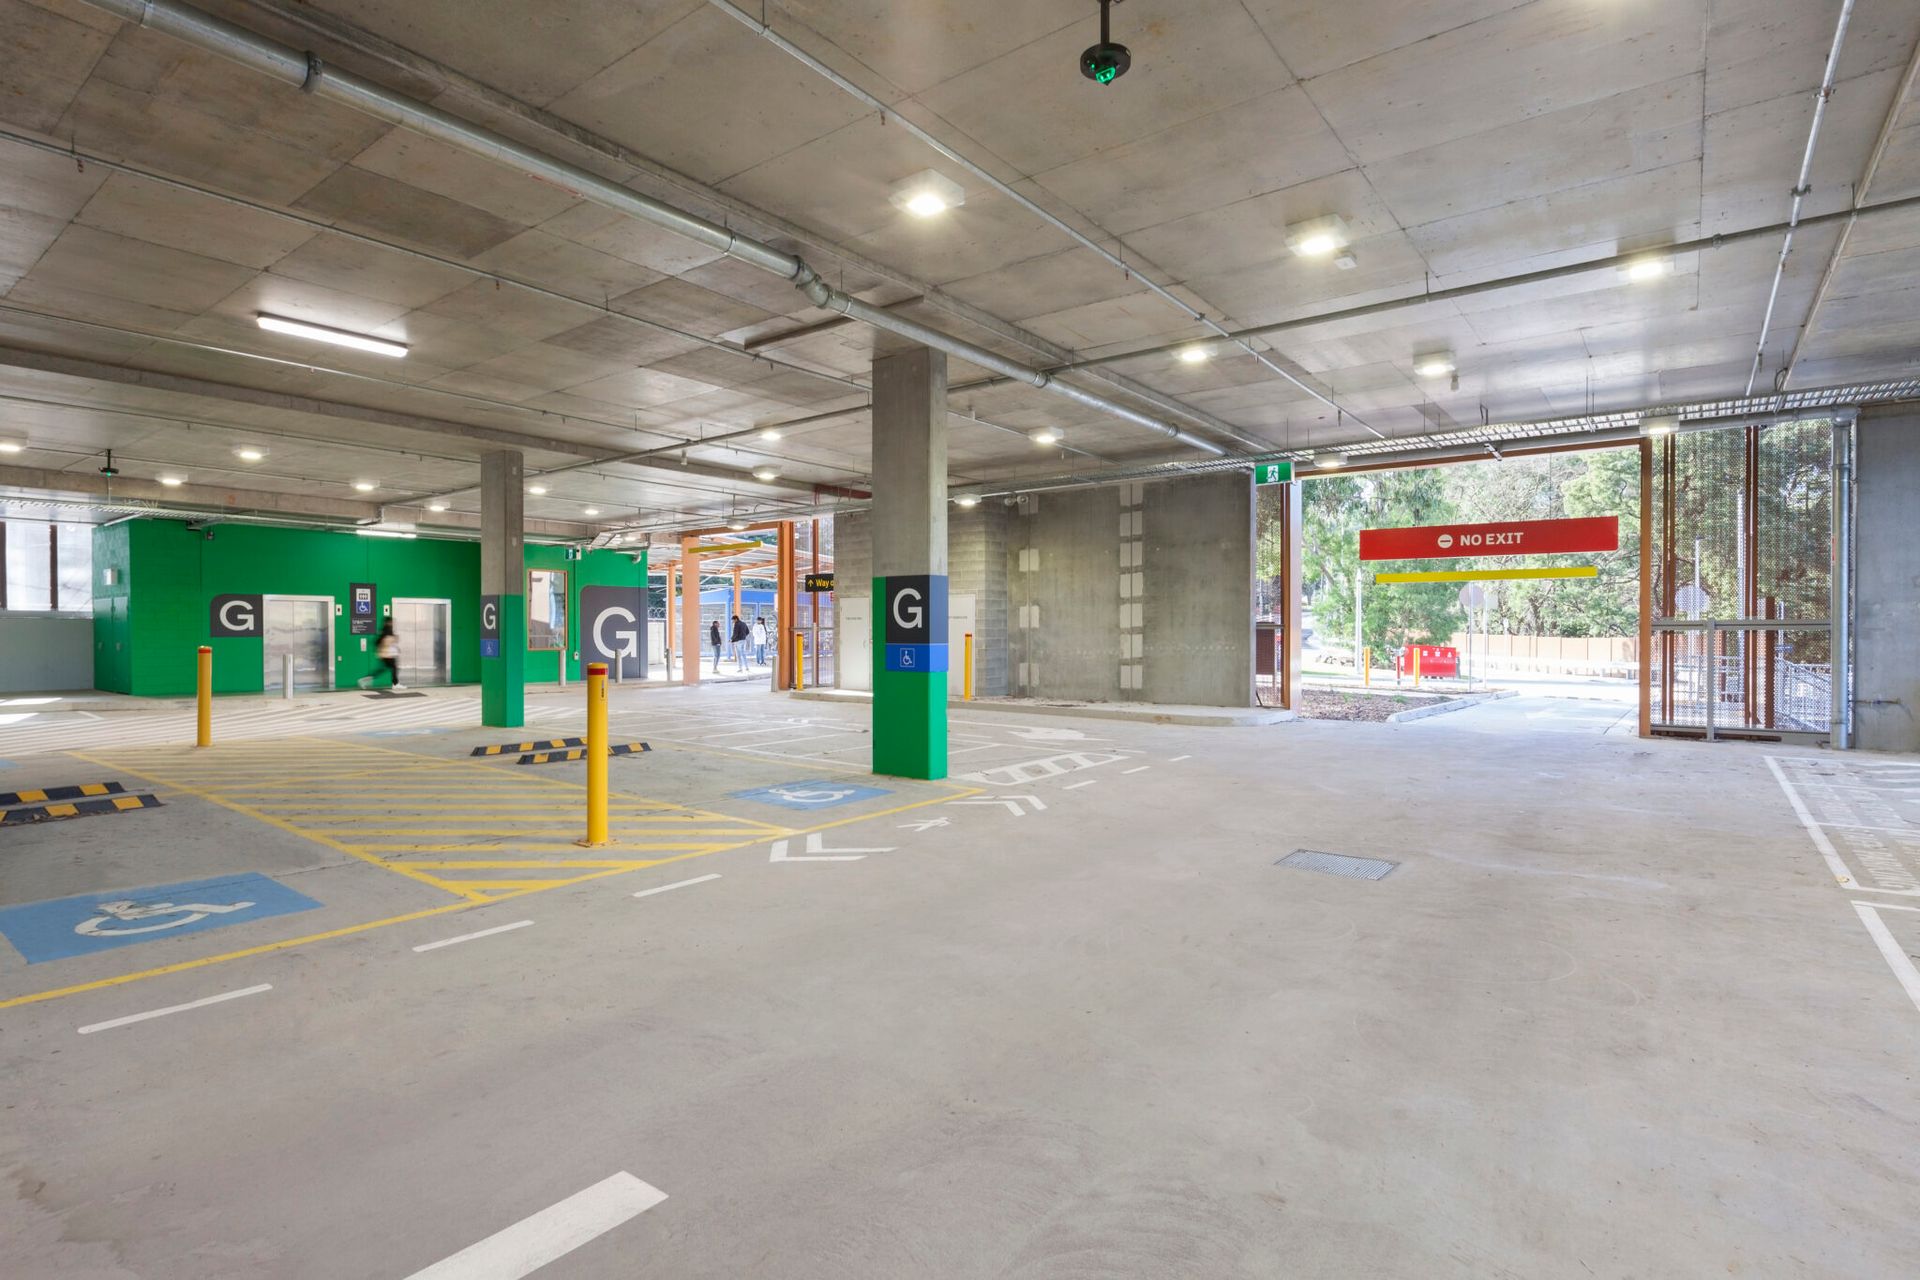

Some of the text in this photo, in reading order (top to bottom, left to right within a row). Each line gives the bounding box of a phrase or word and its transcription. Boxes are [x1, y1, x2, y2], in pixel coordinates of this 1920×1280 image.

[1460, 532, 1524, 546] NO EXIT
[815, 579, 830, 589] Way
[219, 600, 254, 631] G
[483, 603, 496, 630] G
[893, 588, 922, 629] G
[593, 606, 637, 659] G
